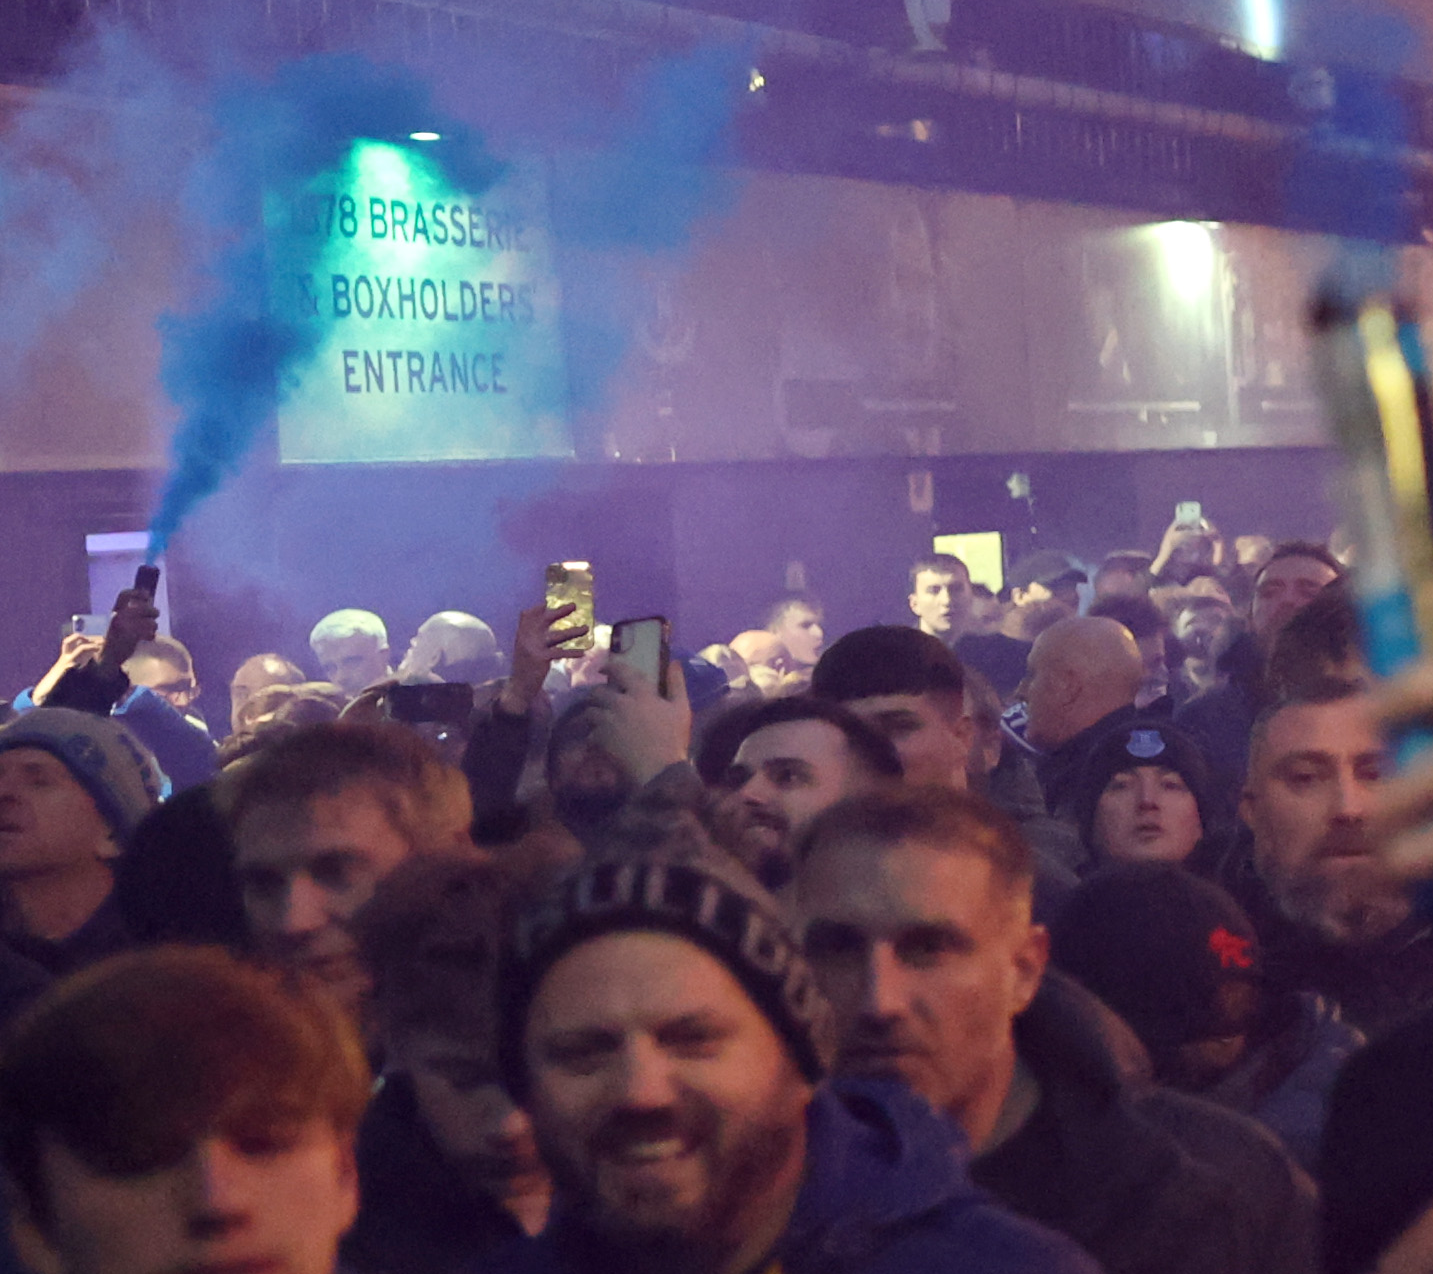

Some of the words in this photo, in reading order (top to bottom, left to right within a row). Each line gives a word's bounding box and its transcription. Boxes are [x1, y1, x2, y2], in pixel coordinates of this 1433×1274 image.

[293, 193, 359, 239] 78
[368, 196, 532, 254] BRASSERIE
[342, 349, 508, 394] ENTRANCE
